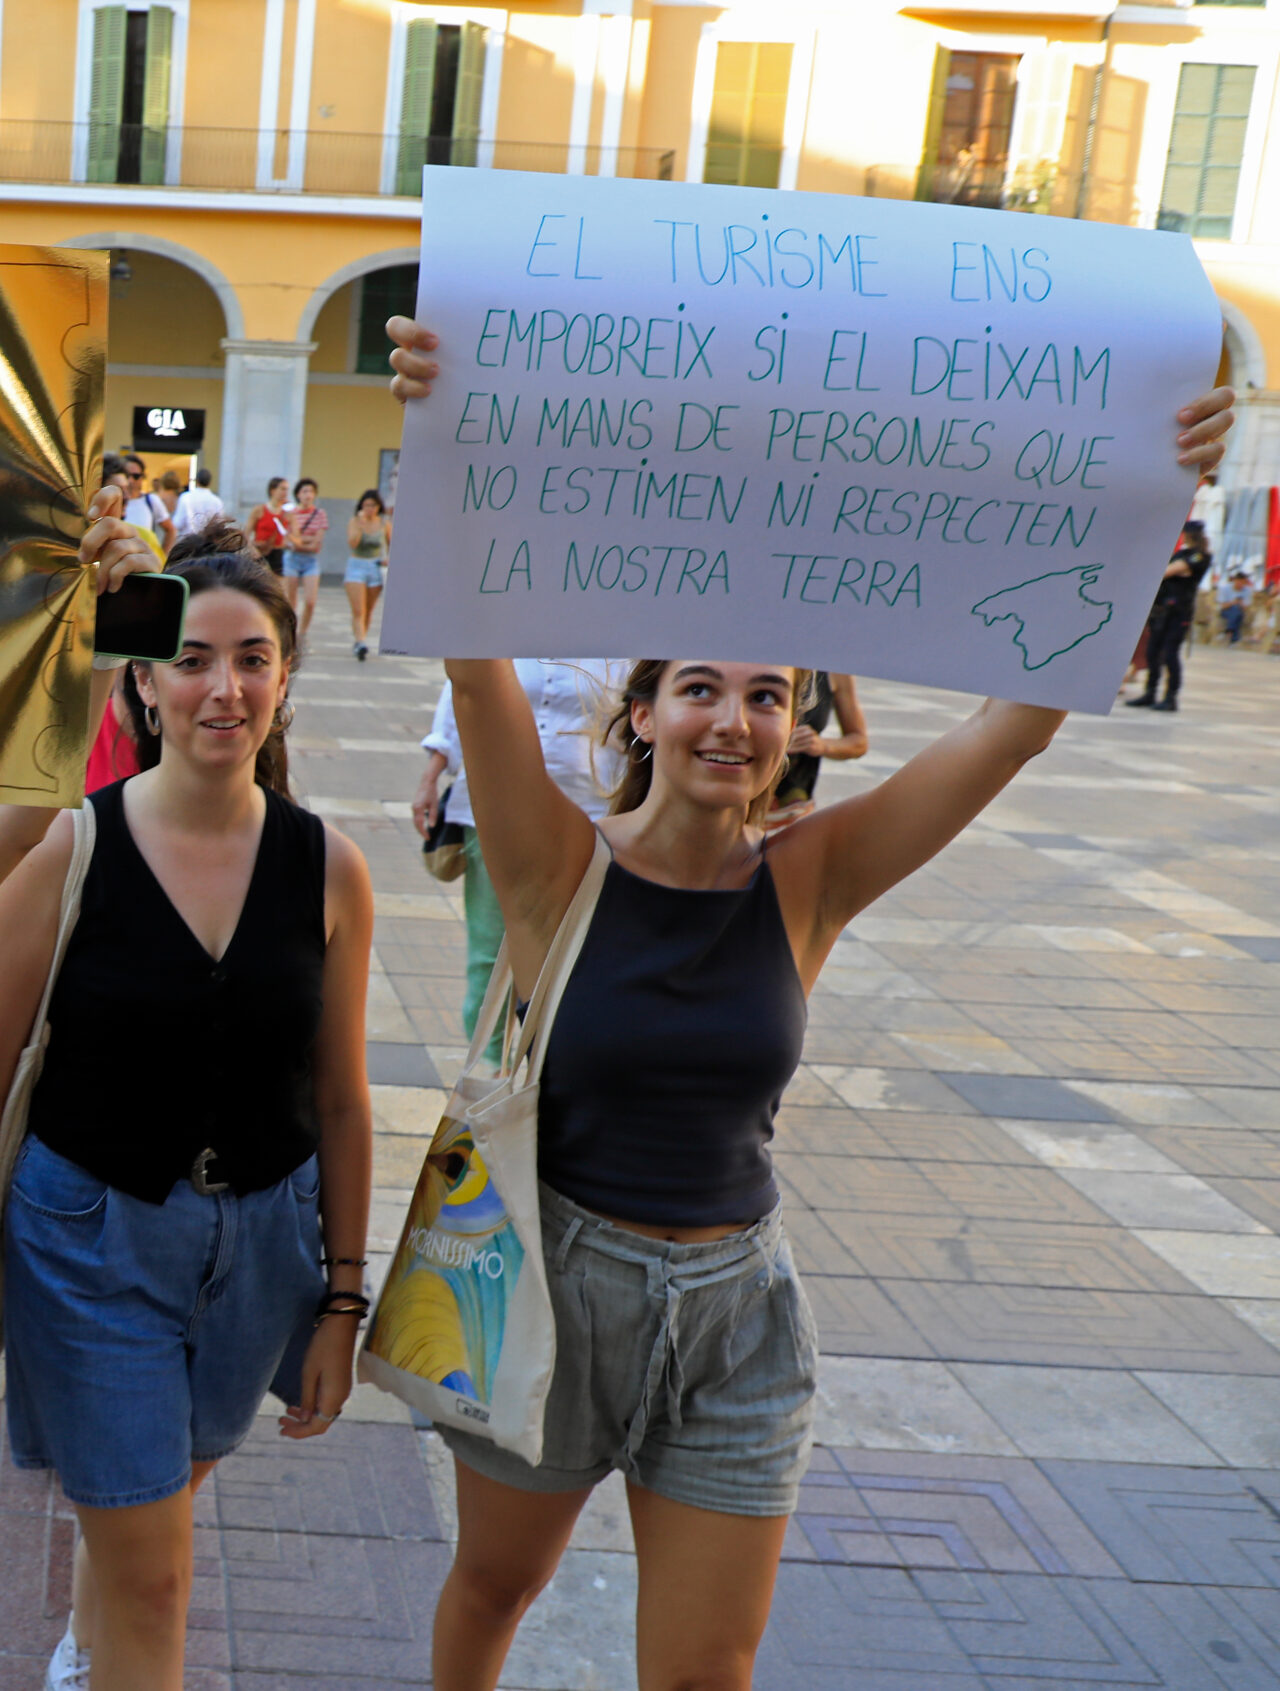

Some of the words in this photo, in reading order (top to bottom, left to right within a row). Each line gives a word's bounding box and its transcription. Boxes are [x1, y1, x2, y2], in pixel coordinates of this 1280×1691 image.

[526, 214, 603, 280] EL
[653, 213, 888, 298] TURISME
[950, 241, 1052, 303] ENS
[476, 302, 716, 381] EMPOBREIX
[747, 312, 789, 385] SI
[823, 329, 881, 392] EL
[910, 325, 1110, 410] DEIXAM
[146, 408, 187, 430] GIA
[455, 391, 520, 445] EN
[535, 396, 653, 451] MANS
[674, 401, 741, 452] DE
[765, 407, 996, 472] PERSONES
[1014, 428, 1116, 490] QUE
[462, 463, 518, 514] NO
[538, 457, 749, 525] ESTIMEN
[766, 471, 821, 529] NI
[832, 485, 1098, 549] RESPECTEN
[479, 538, 533, 594] LA
[562, 540, 730, 597] NOSTRA
[770, 552, 922, 609] TERRA
[405, 1225, 505, 1280] MORNISSIMO
